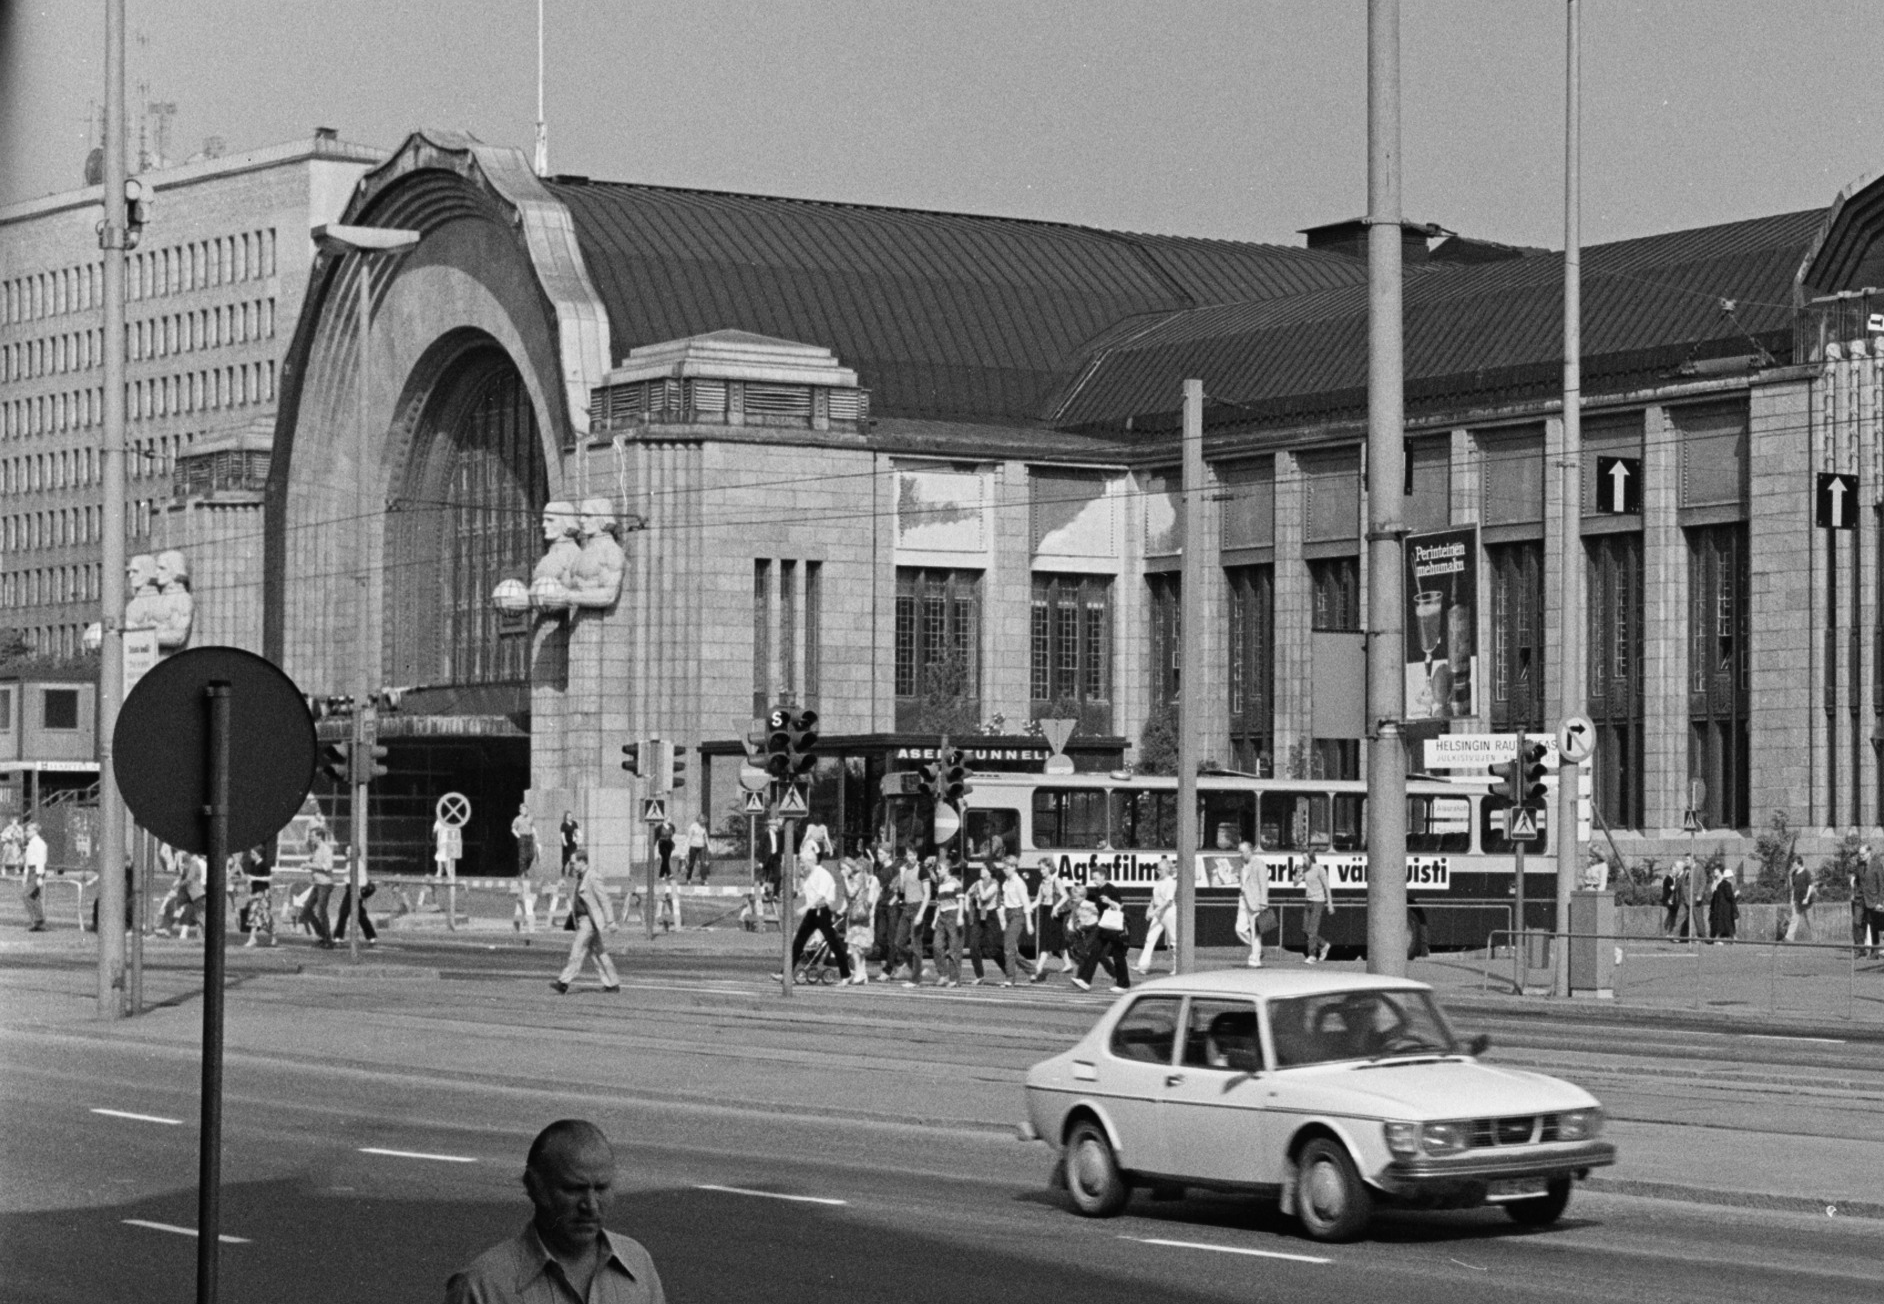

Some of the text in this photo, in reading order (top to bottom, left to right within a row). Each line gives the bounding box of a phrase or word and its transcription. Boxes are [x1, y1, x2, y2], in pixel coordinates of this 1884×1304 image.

[1415, 542, 1465, 562] Perinteinen
[771, 711, 782, 726] S
[1436, 740, 1490, 751] HELSINGIN
[897, 748, 1050, 760] ASEUNNELI
